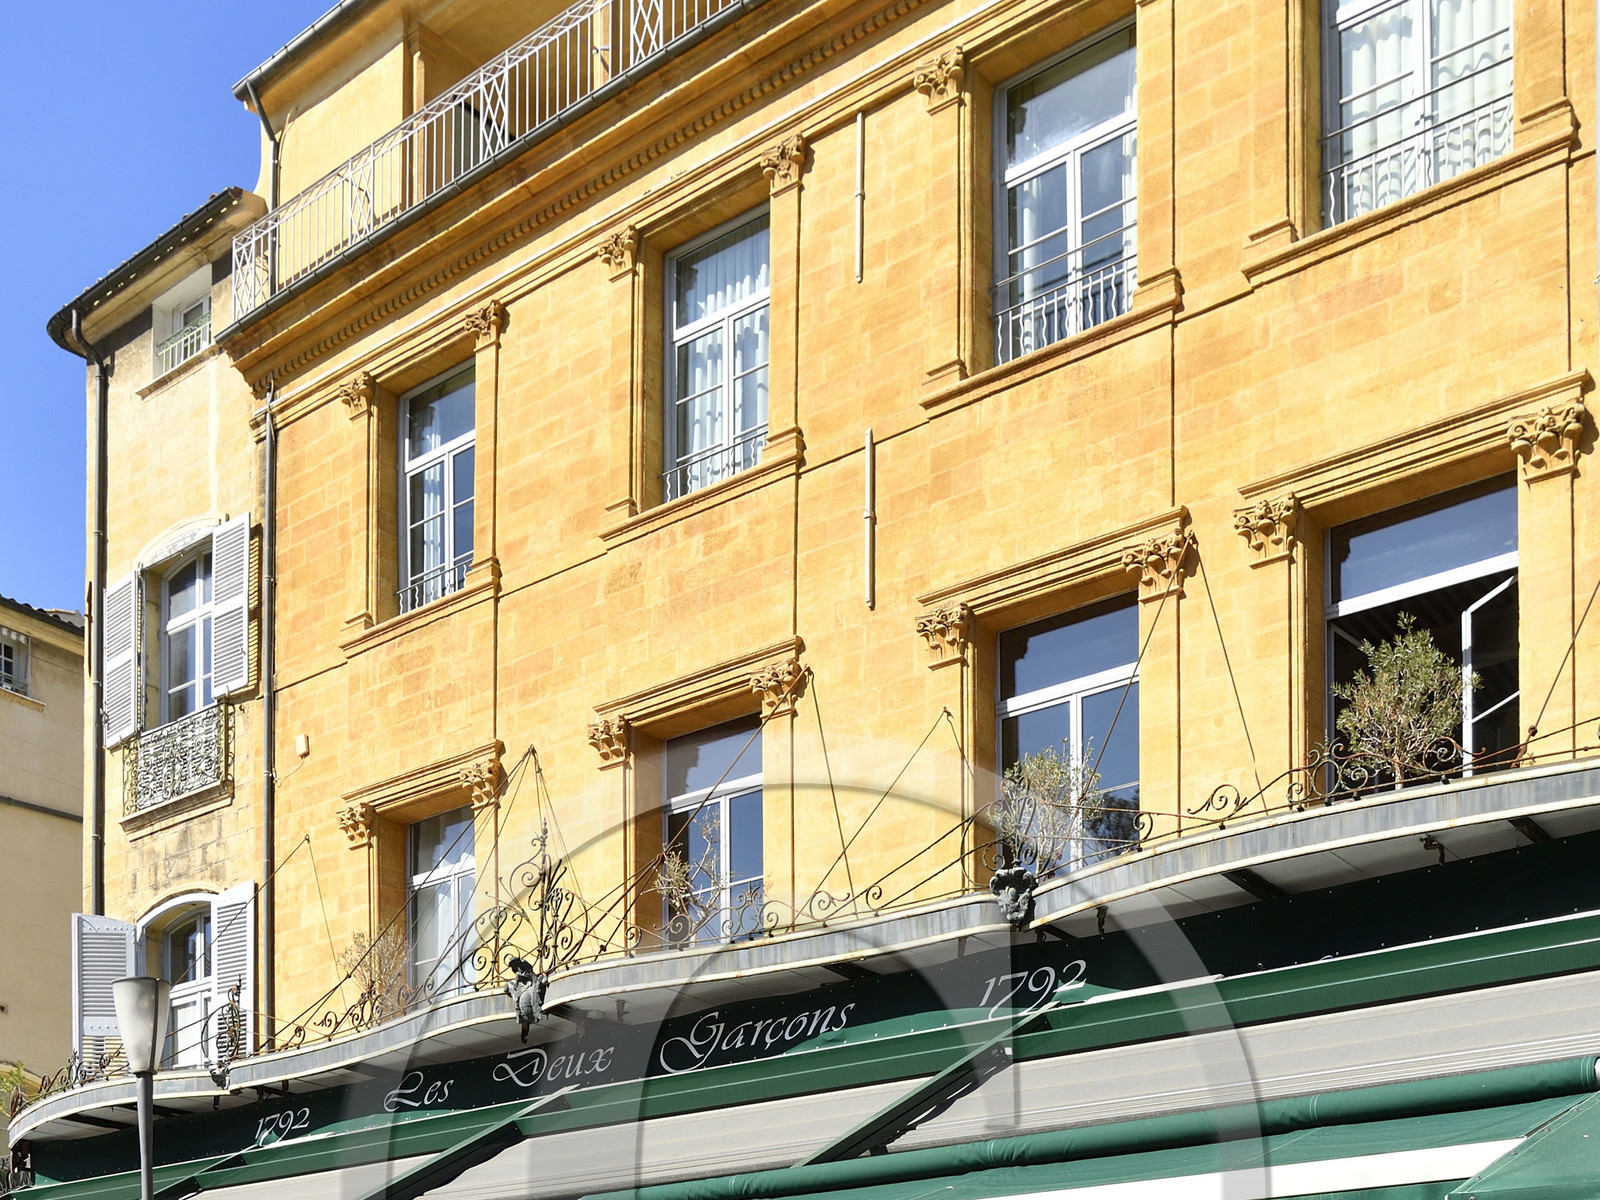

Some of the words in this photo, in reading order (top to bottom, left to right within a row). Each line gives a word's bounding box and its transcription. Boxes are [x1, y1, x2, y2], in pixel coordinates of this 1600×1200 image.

[256, 1107, 310, 1144] 1792
[383, 1071, 454, 1112] Les
[492, 1047, 615, 1087] Deux
[659, 1002, 856, 1073] Garçons
[979, 959, 1087, 1019] 1792
